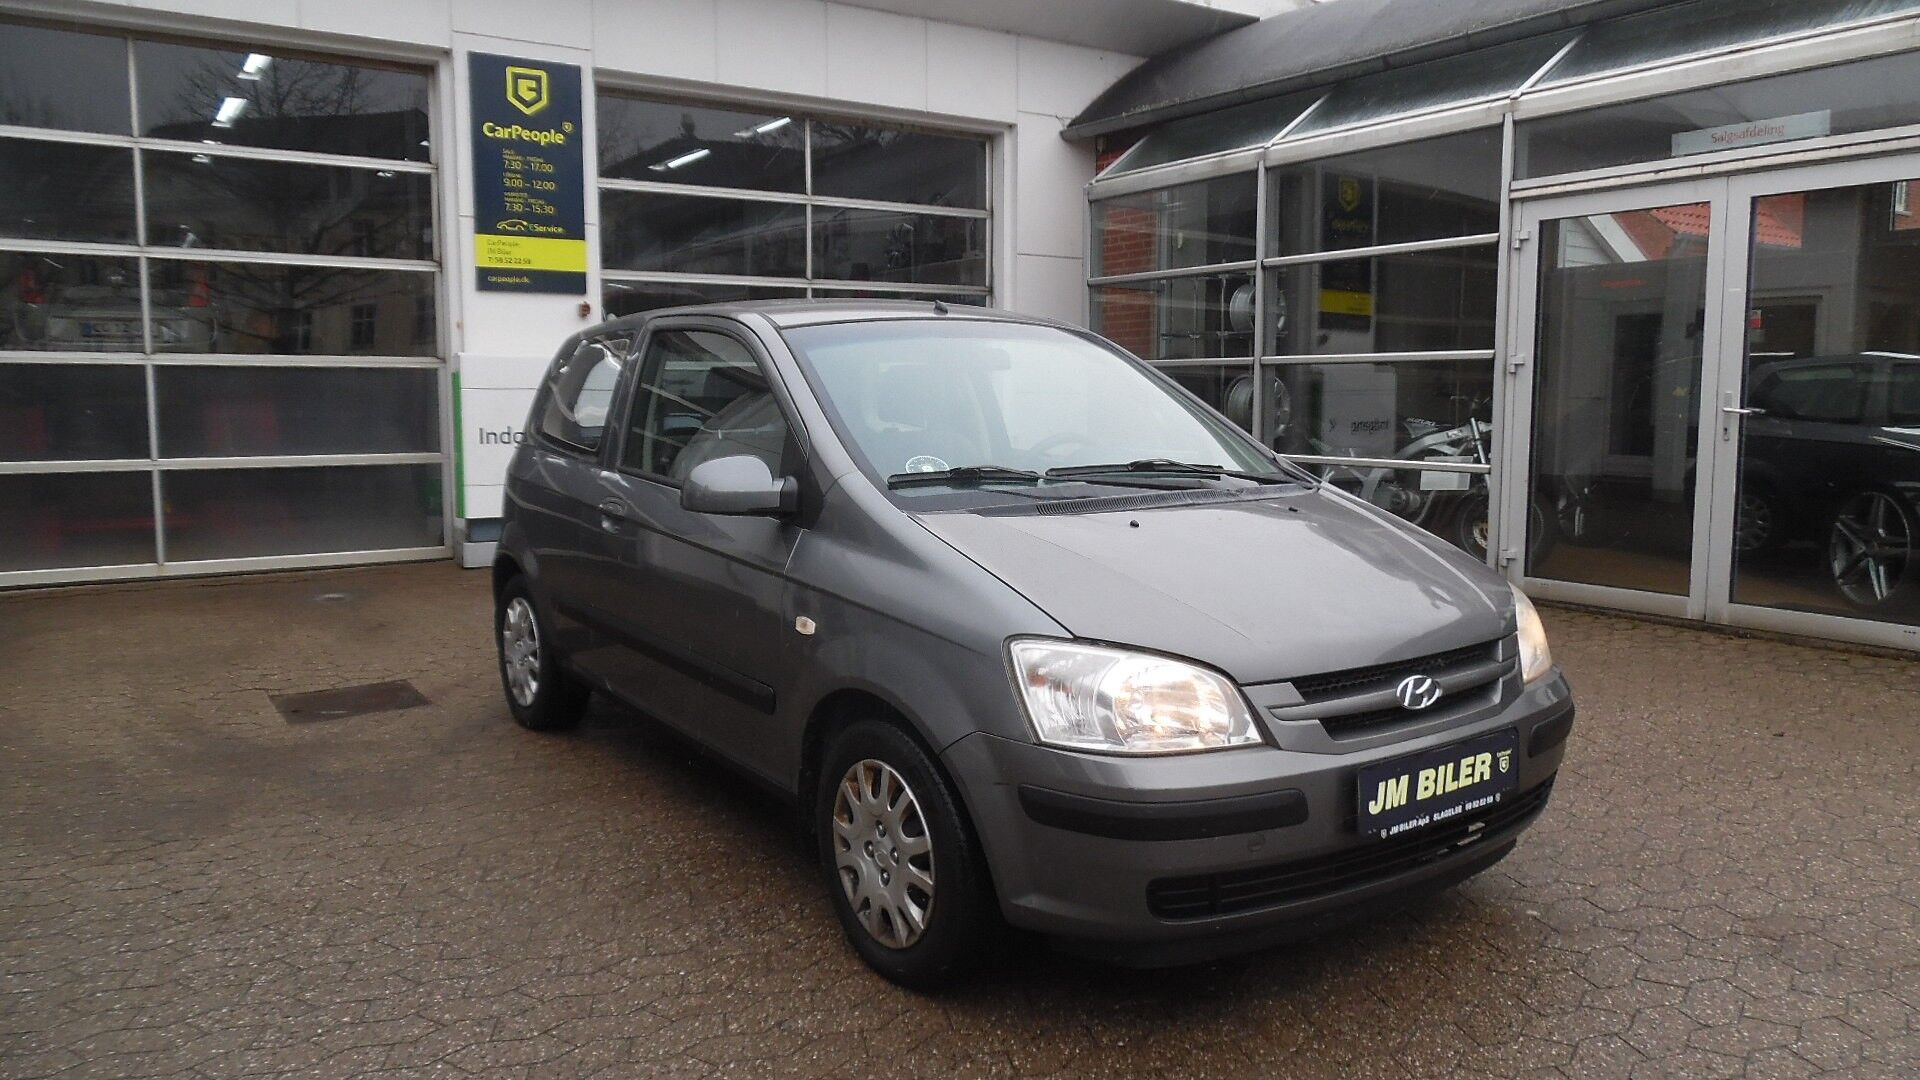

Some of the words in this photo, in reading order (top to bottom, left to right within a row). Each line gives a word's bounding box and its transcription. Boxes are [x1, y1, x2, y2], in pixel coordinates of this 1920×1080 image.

[482, 121, 565, 146] CarPeople
[1711, 124, 1785, 144] Salgsafdeling
[503, 159, 521, 170] 7.30
[531, 162, 553, 172] 17.00
[1368, 774, 1410, 816] JM
[1416, 751, 1492, 801] BILER
[1399, 818, 1417, 832] BILER
